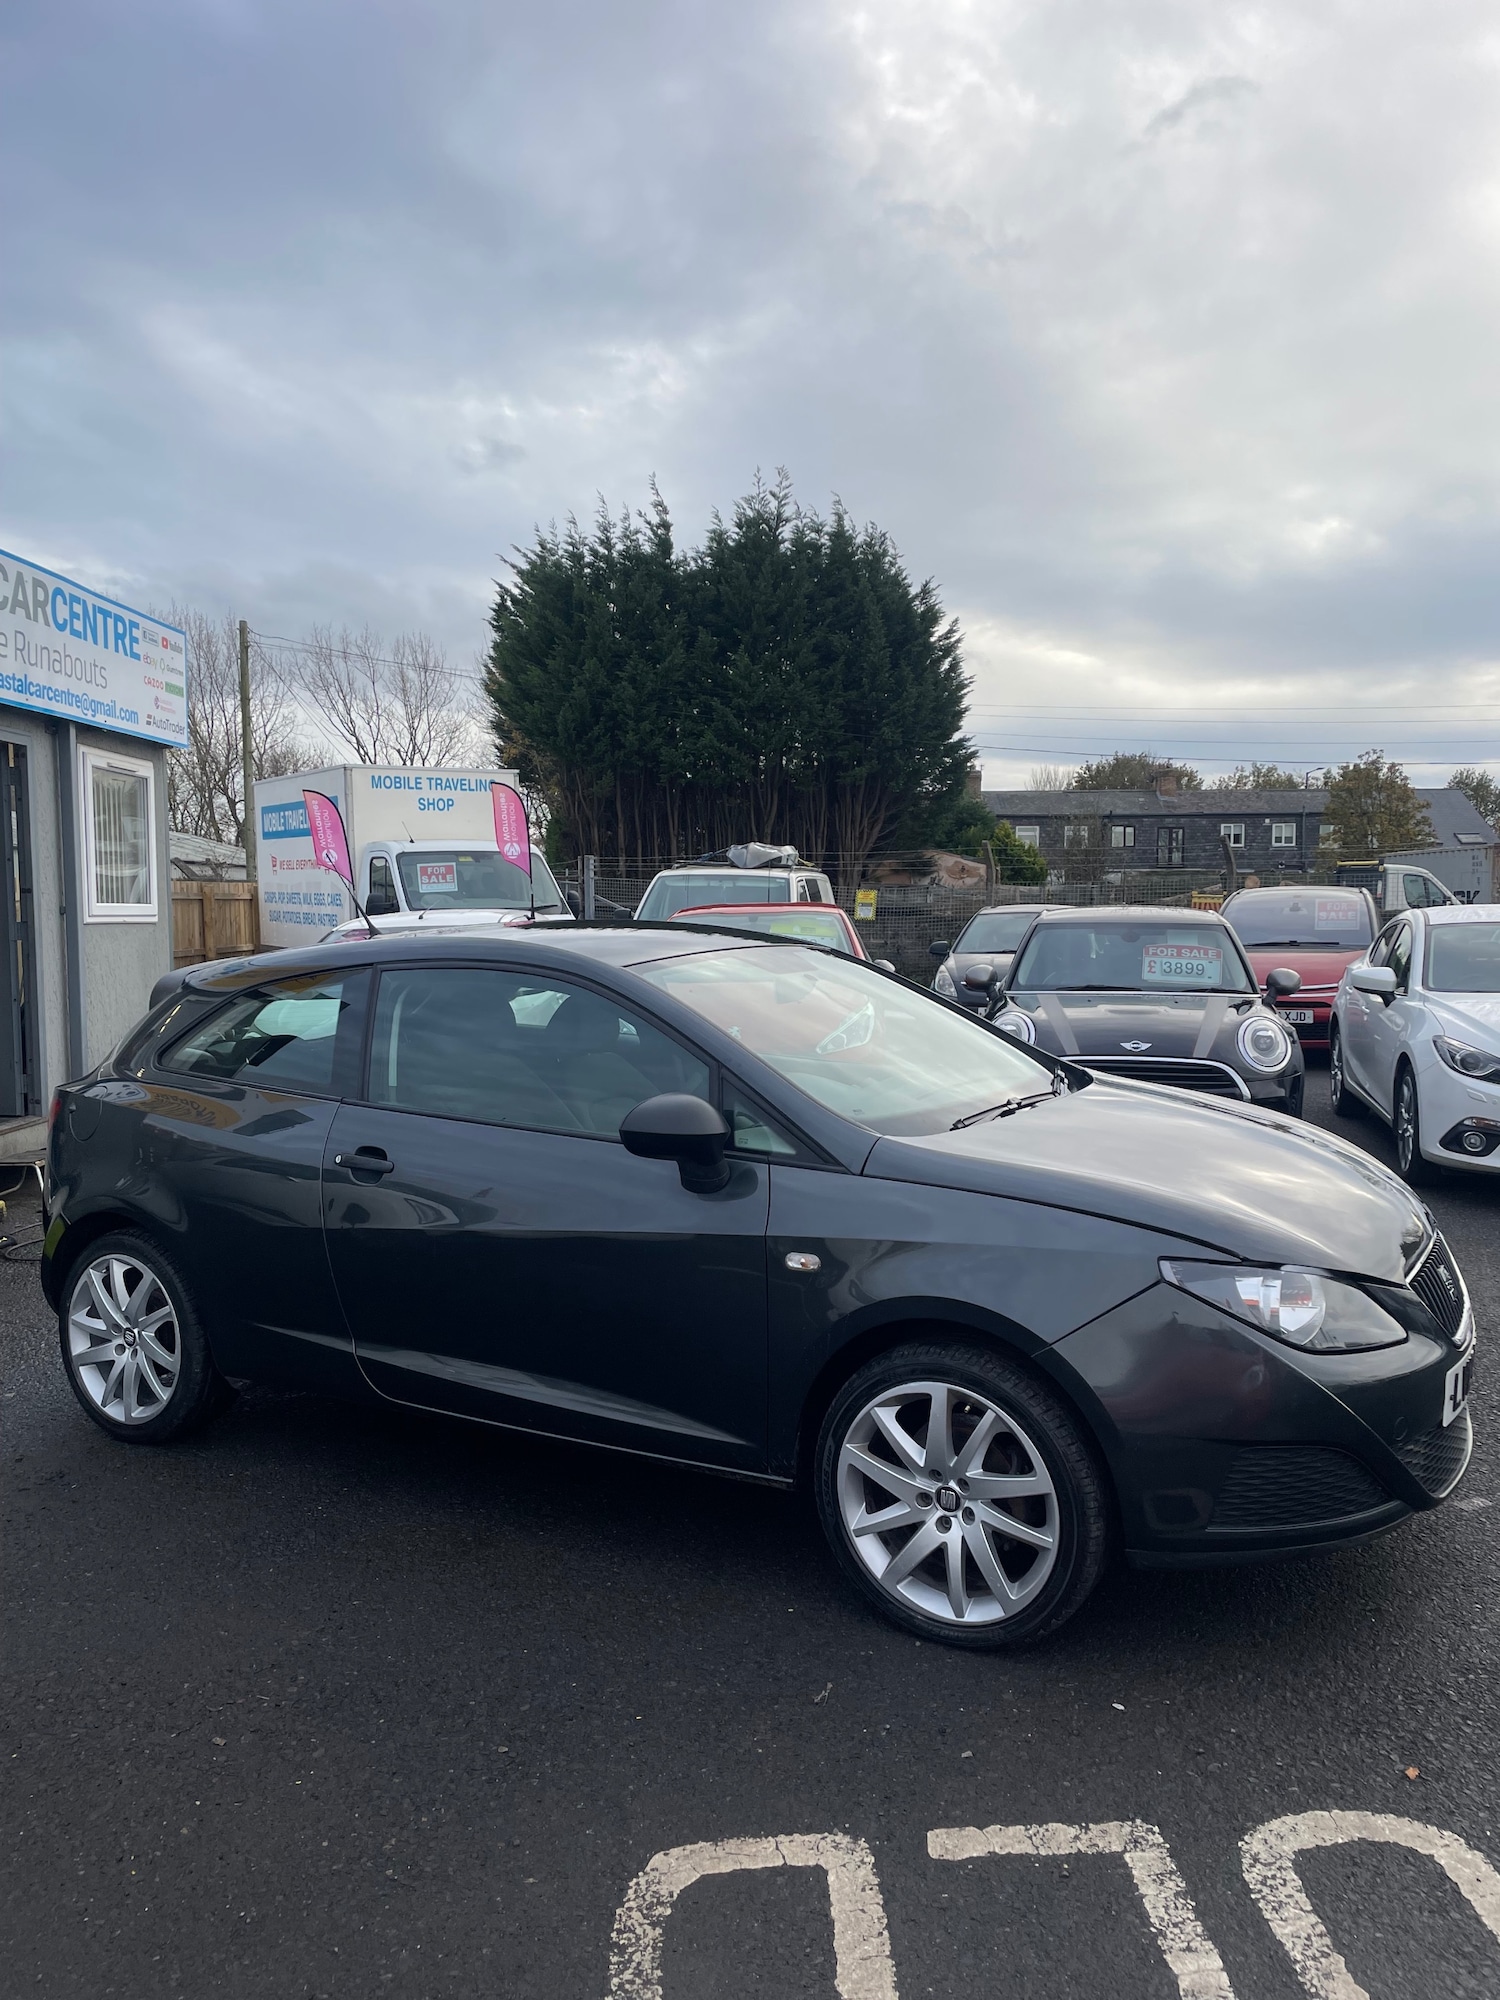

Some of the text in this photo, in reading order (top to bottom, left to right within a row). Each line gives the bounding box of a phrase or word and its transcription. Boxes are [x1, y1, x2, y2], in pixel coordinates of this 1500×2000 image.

[14, 630, 108, 689] Runabouts
[152, 715, 185, 735] AutoTrader
[371, 775, 423, 790] MOBILE
[418, 797, 454, 811] SHOP
[263, 808, 308, 832] MOBILE TRAVEL
[421, 875, 454, 883] SALE
[1327, 902, 1348, 910] FOR
[1318, 911, 1356, 920] SALE
[1148, 947, 1217, 958] FOR SALE
[1147, 960, 1205, 976] £ 3899
